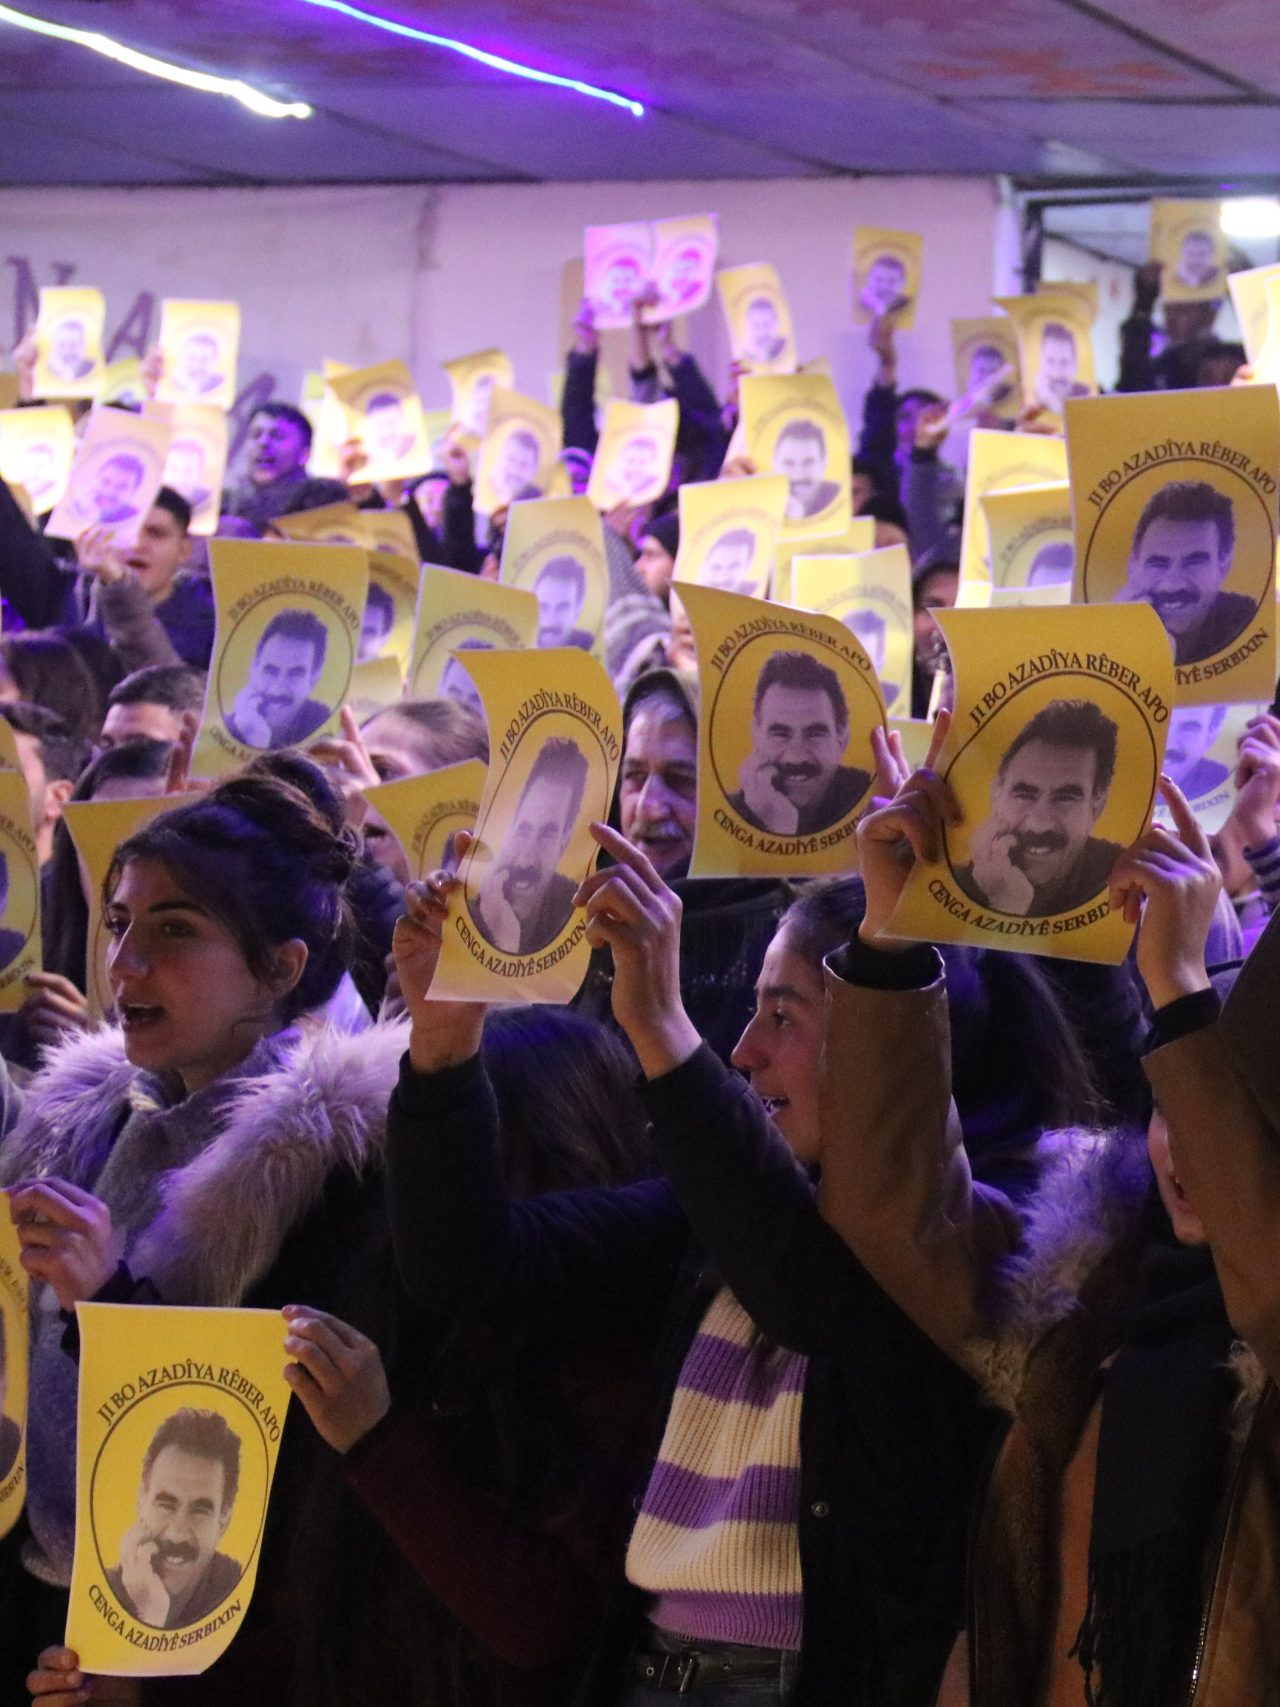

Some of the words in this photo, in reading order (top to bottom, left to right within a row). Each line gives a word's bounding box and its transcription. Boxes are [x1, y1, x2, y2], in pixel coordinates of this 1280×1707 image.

[1087, 492, 1104, 509] JI
[1099, 469, 1123, 495] BO
[1122, 438, 1196, 476] AZADÎYA
[1200, 440, 1250, 473] RÊBER
[1249, 466, 1277, 496] APO
[717, 635, 737, 659] BO
[734, 616, 789, 644] AZADÎYA
[789, 621, 838, 649] RÊBER
[710, 654, 727, 673] JI
[839, 645, 872, 672] APO
[1203, 627, 1269, 680] SERBIXIN
[969, 705, 986, 726] JI
[982, 682, 1007, 711] BO
[1007, 648, 1083, 689] AZADÎYA
[1086, 653, 1142, 693] RÊBER
[1138, 686, 1169, 724] APO
[518, 688, 565, 727] AZADÎYA
[563, 692, 602, 730] RÊBER
[505, 719, 521, 744] BO
[600, 725, 620, 762] APO
[500, 741, 512, 764] JI
[712, 808, 753, 848] CENGA
[756, 836, 819, 856] AZADÎYÊ
[820, 816, 857, 850] SERBI
[928, 879, 969, 922] CENGA
[969, 914, 1050, 936] AZADÎYÊ
[1052, 901, 1109, 934] SERBI
[455, 916, 485, 965] CENGA
[485, 955, 535, 978] AZADÎYÊ
[535, 918, 587, 974] SERBIXIN
[97, 1404, 115, 1427] JI
[110, 1383, 136, 1409] BO
[138, 1358, 215, 1394] AZADÎYA
[218, 1369, 265, 1410] RÊBER
[259, 1405, 281, 1442] APO
[88, 1584, 126, 1638] CENGA
[125, 1632, 180, 1652] AZADÎYÊ
[179, 1599, 242, 1649] SERBIXIN
